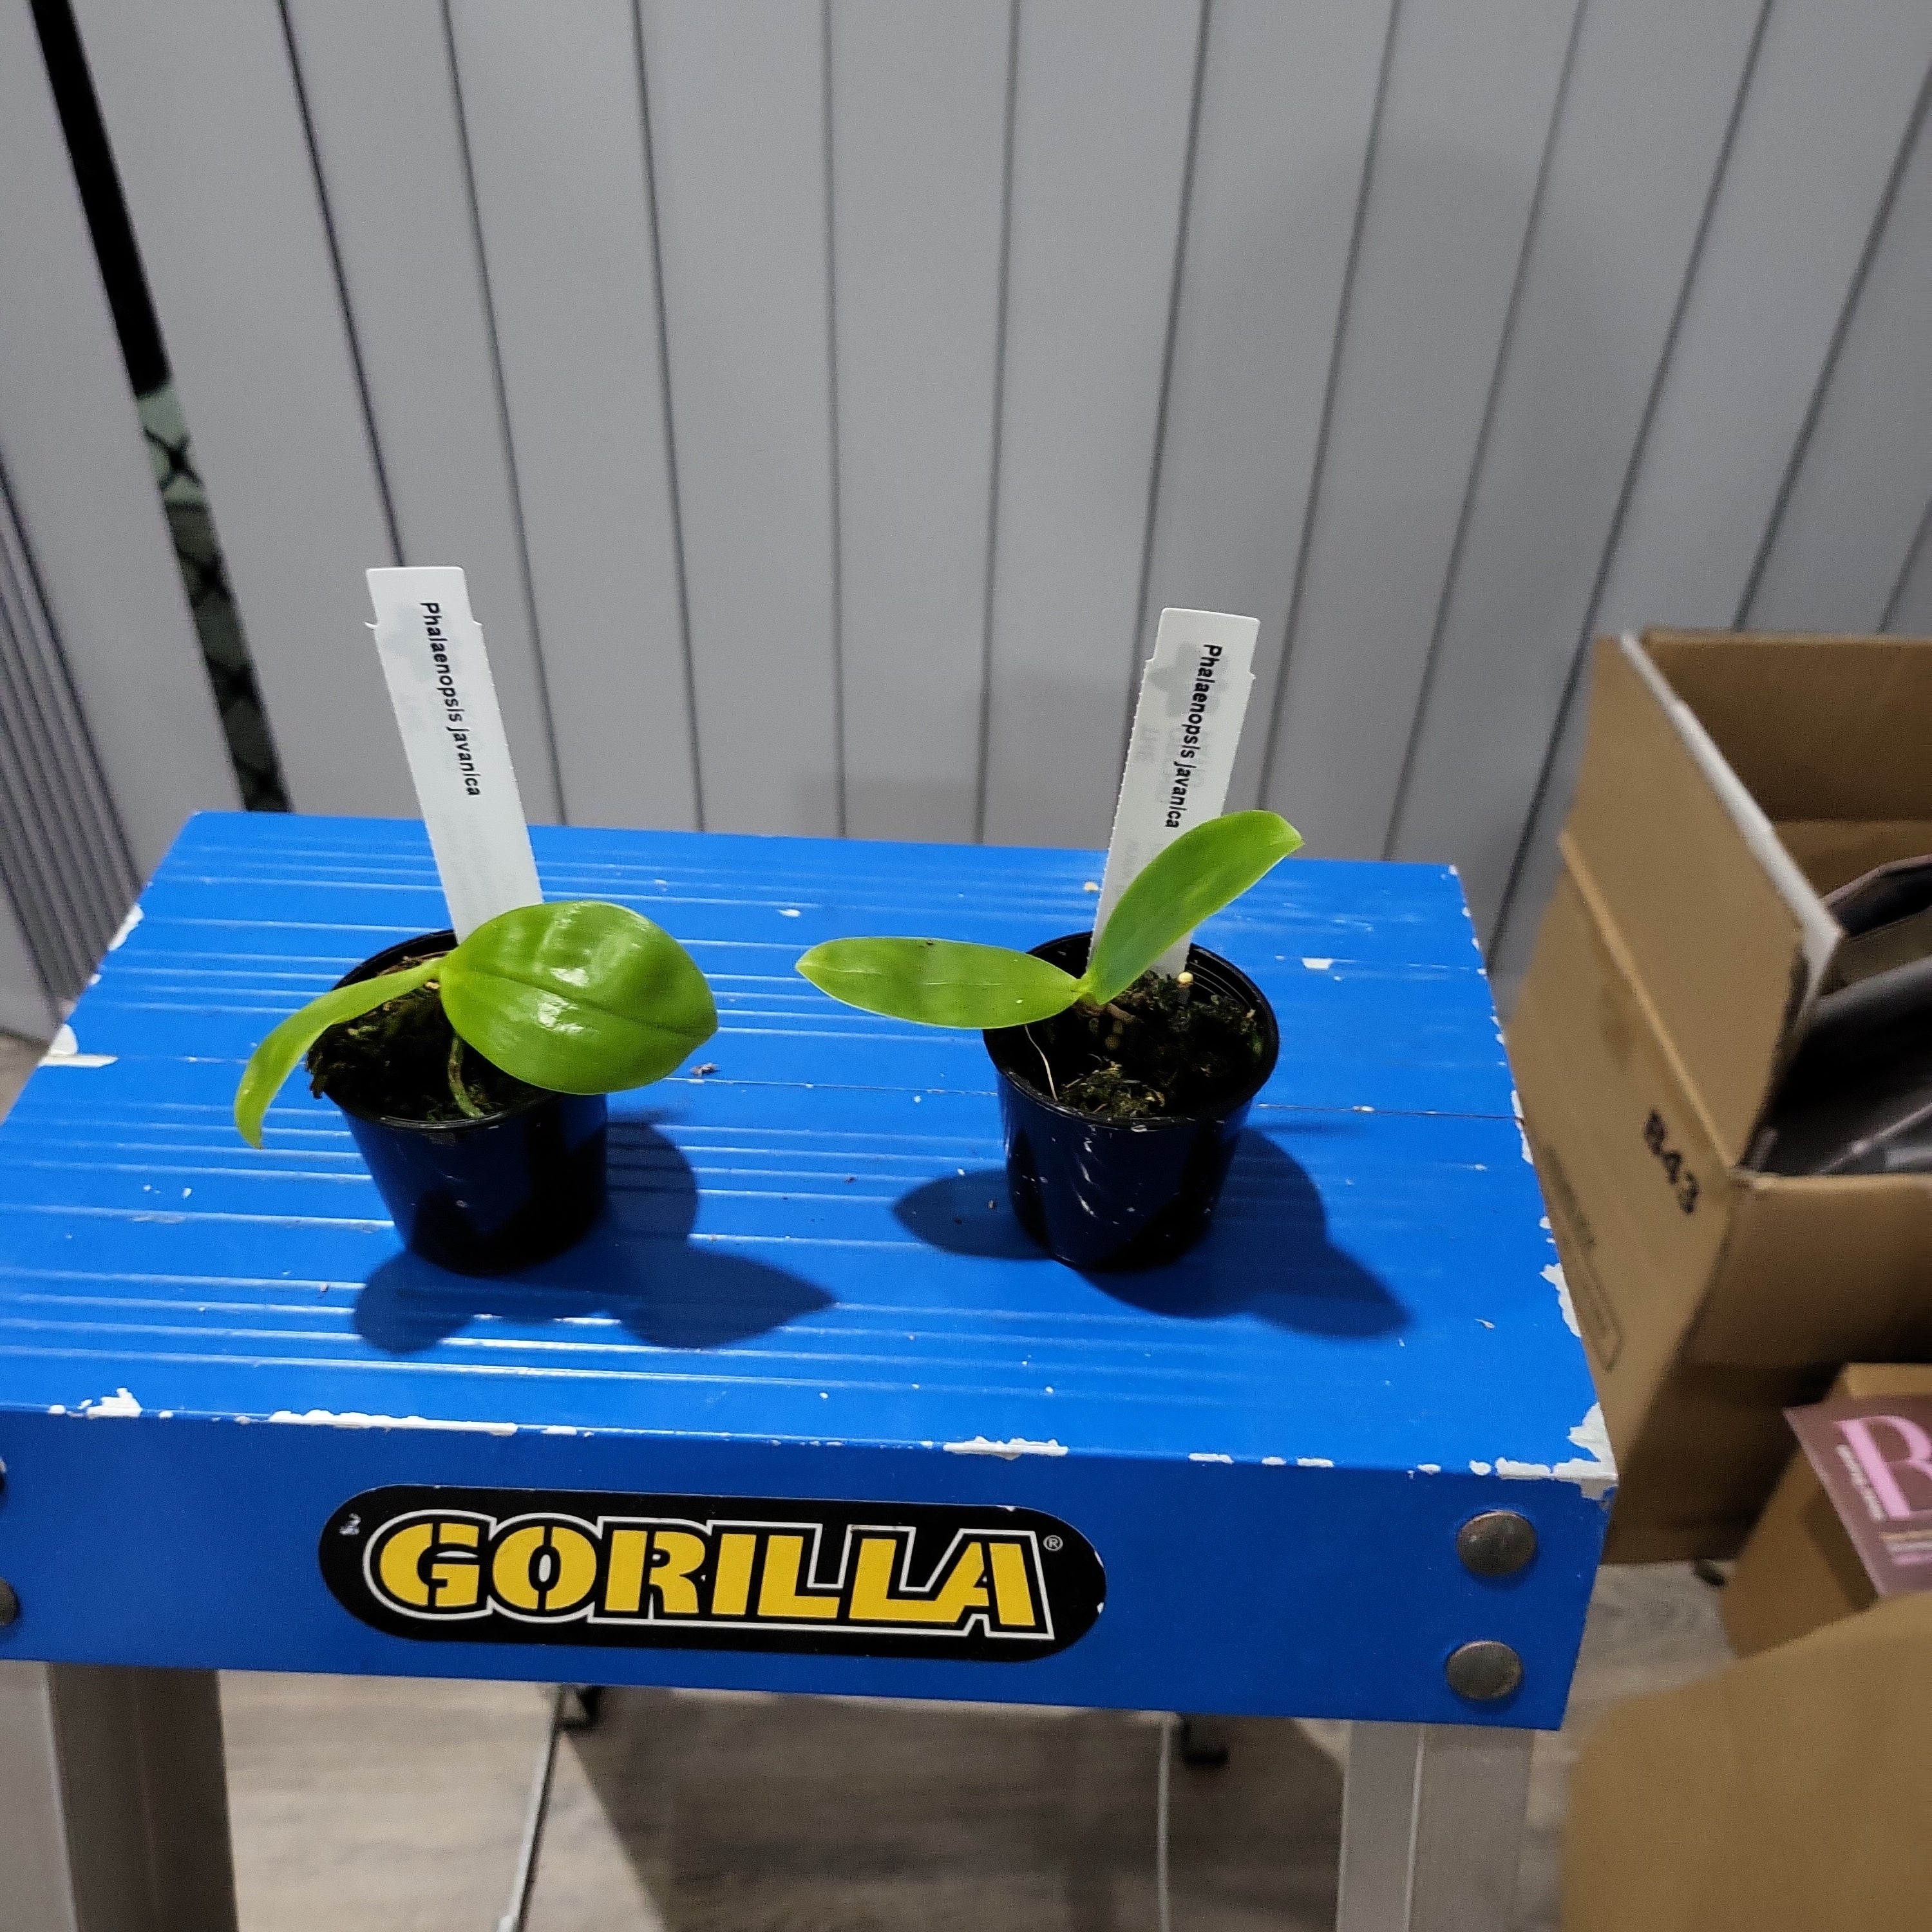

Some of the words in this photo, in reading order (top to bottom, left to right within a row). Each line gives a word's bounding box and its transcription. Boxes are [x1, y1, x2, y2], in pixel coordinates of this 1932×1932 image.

[420, 602, 464, 723] Phalaenopsis
[446, 726, 481, 796] javanica
[1180, 643, 1223, 759] Phalaenopsis
[1164, 760, 1197, 829] javanica
[372, 1519, 1043, 1631] GORILLA
